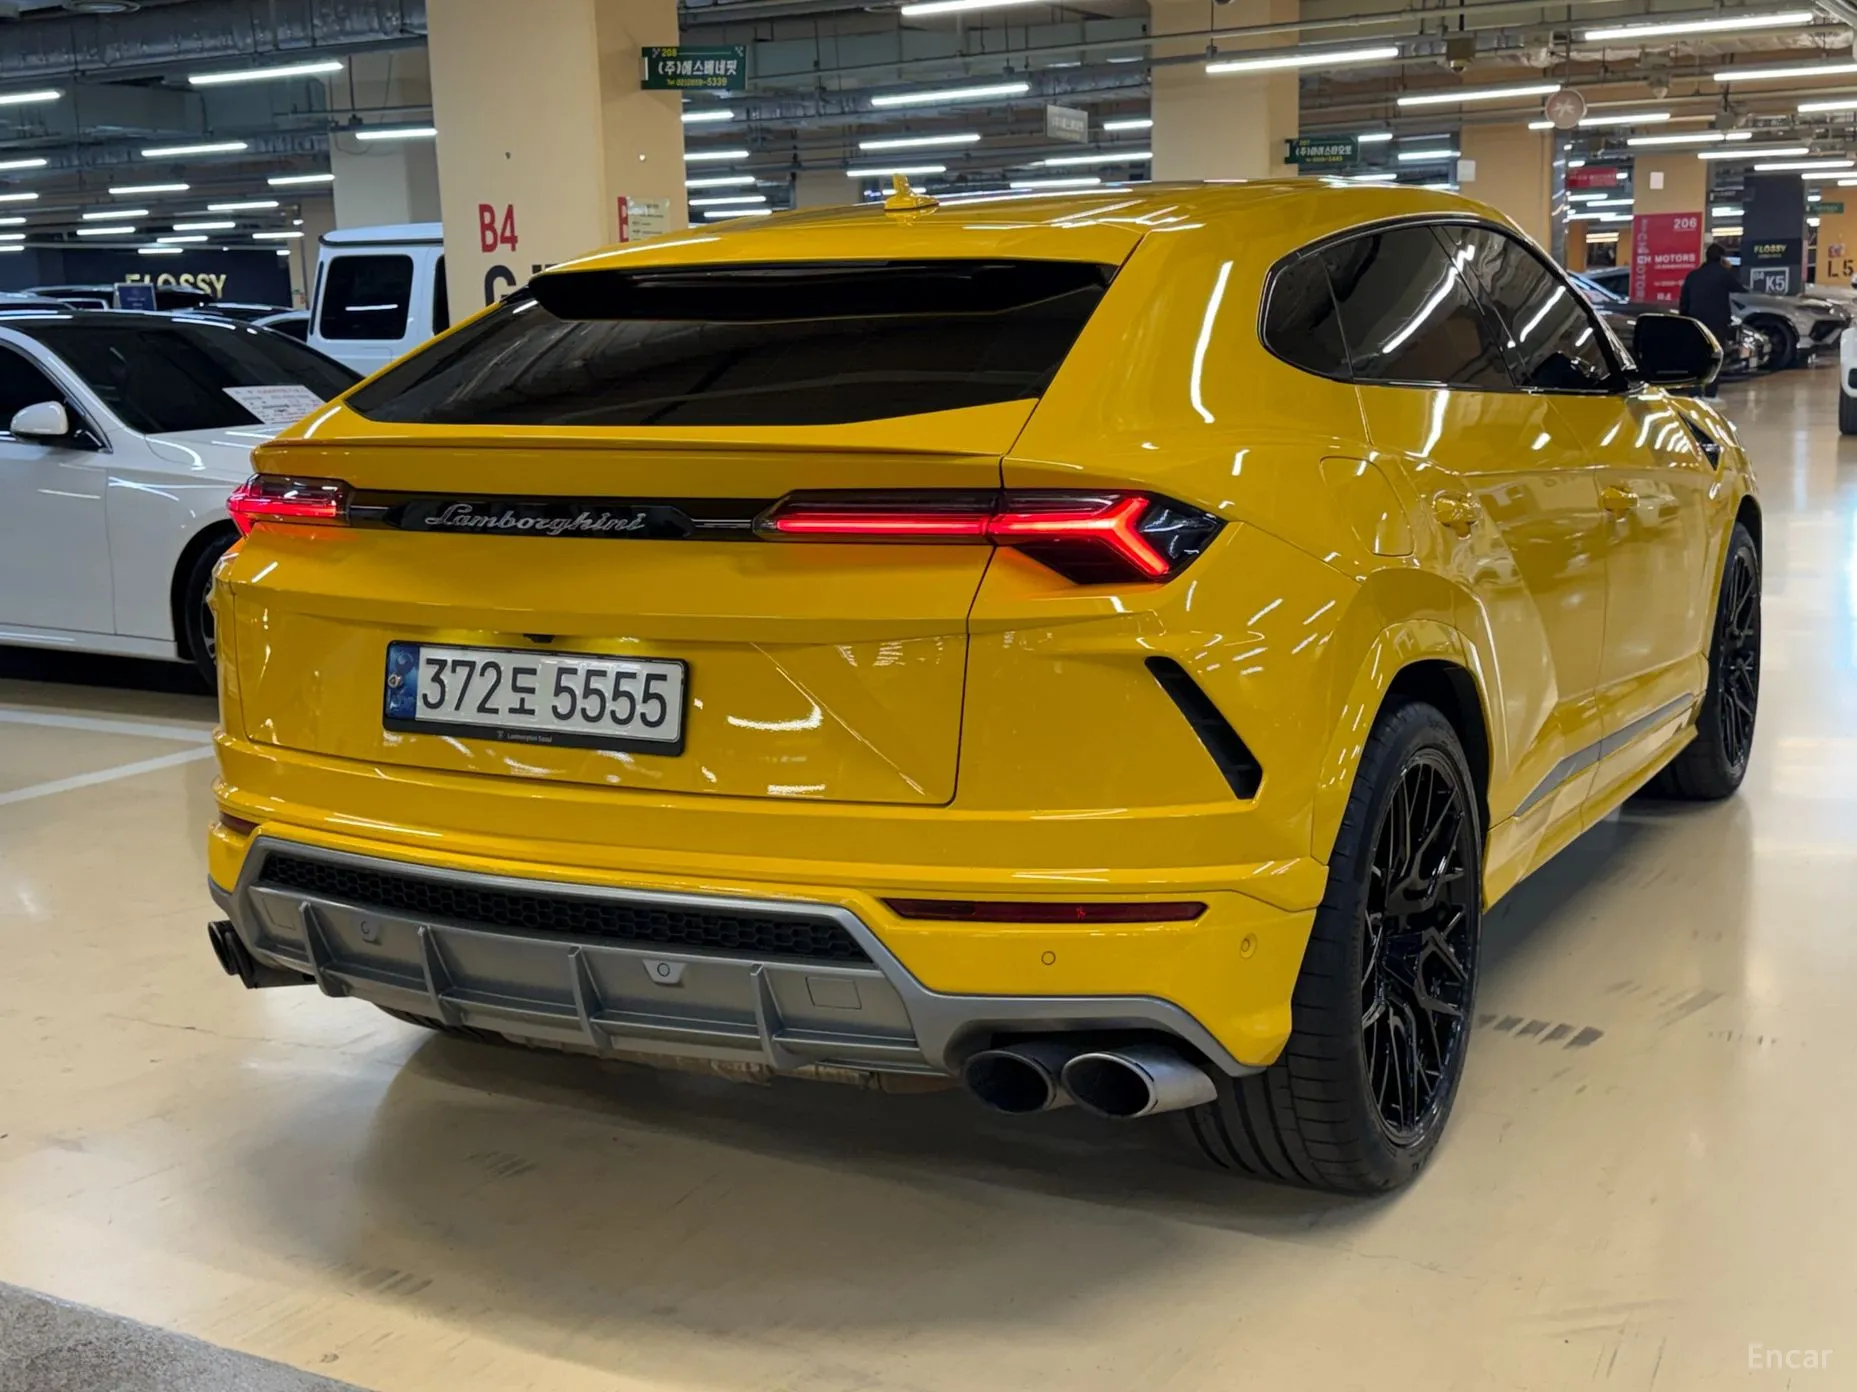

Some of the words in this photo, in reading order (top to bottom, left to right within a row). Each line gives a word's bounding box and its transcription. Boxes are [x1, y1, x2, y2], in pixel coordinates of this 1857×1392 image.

[479, 203, 518, 253] B4
[1673, 218, 1697, 230] 206
[1654, 253, 1696, 263] MOTORS
[1753, 244, 1787, 255] FLOSSY
[1765, 275, 1785, 293] K5
[424, 503, 648, 536] Lamborghini
[422, 658, 538, 716] 372도
[551, 667, 668, 729] 5555
